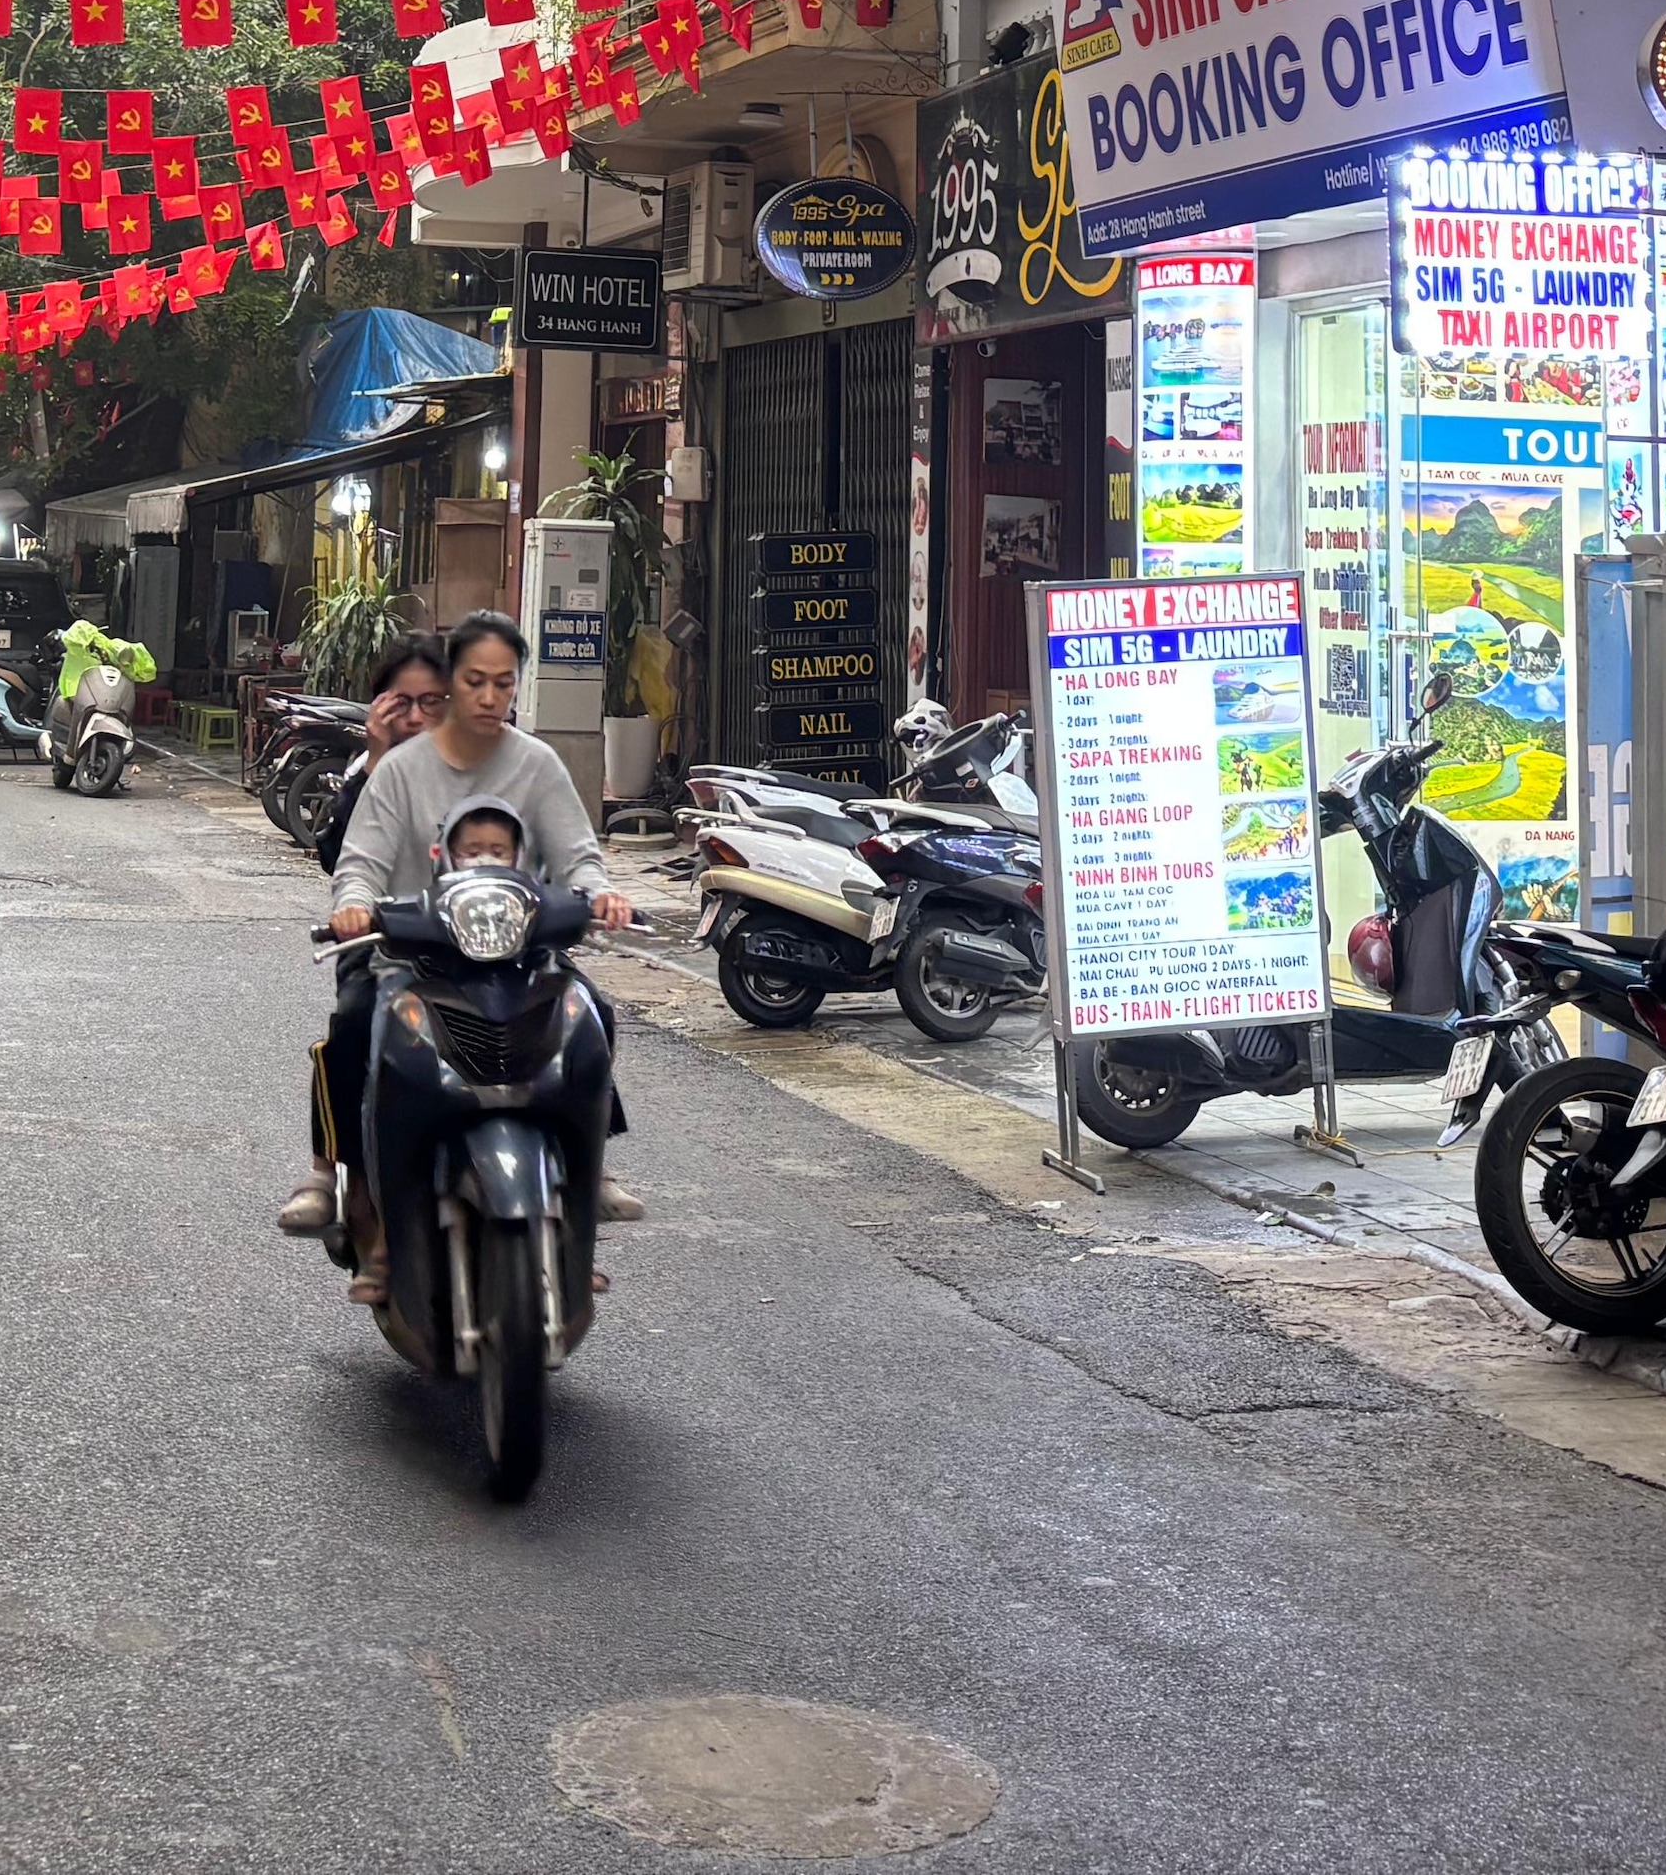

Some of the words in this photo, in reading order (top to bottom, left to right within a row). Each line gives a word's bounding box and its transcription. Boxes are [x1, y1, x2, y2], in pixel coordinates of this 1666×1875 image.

[1066, 43, 1090, 66] SINH
[1090, 35, 1114, 58] CAFE
[1088, 34, 1307, 172] BOOKING
[1481, 128, 1510, 153] 986
[1510, 122, 1540, 152] 309
[1540, 116, 1572, 145] 082
[1412, 160, 1537, 212] BOOKING
[1545, 164, 1637, 214] OFFICE
[793, 206, 828, 221] 1995
[829, 194, 886, 227] Spa
[926, 157, 1001, 263] 1995
[1108, 217, 1121, 240] 28
[1121, 213, 1148, 241] Hang
[1148, 206, 1174, 231] Hanh
[1175, 199, 1207, 225] street
[771, 230, 798, 246] BODY
[803, 230, 829, 246] FOOT
[832, 230, 856, 246] NAIL
[861, 231, 903, 247] WAXING
[1414, 217, 1500, 260] MONEY
[1511, 221, 1639, 265] EXCHANGE
[802, 252, 843, 268] PRIVATE
[844, 252, 873, 268] ROOM
[1156, 263, 1194, 286] LONG
[1199, 262, 1245, 284] BAY
[1416, 265, 1463, 303] SIM
[1472, 267, 1505, 304] 5G
[1532, 268, 1636, 308] LAUNDRY
[531, 272, 575, 304] WIN
[583, 275, 652, 308] HOTEL
[537, 315, 554, 330] 34
[557, 318, 597, 332] HANG
[601, 320, 642, 335] HANH
[1437, 310, 1492, 347] TAXI
[1503, 312, 1620, 350] AIRPORT
[914, 363, 931, 379] Come
[914, 383, 931, 399] Relax
[913, 424, 930, 444] Enjoy
[1302, 423, 1324, 475] TOUR
[1428, 468, 1455, 480] TAM
[1459, 469, 1481, 481] COC
[1500, 471, 1529, 483] MUA
[1533, 472, 1564, 485] CAVE
[1109, 472, 1132, 521] FOOT
[1320, 485, 1338, 511] Long
[1340, 485, 1354, 511] Bay
[1304, 526, 1323, 552] Sapa
[790, 542, 848, 565] BODY
[794, 598, 848, 622] FOOT
[1051, 586, 1147, 631] MONEY
[1155, 581, 1297, 626] EXCHANGE
[589, 620, 601, 635] XE
[1064, 636, 1115, 667] SIM
[1121, 633, 1155, 664] 5G
[1177, 627, 1289, 662] LAUNDRY
[771, 653, 874, 681] SHAMPOO
[1065, 673, 1088, 691] HA
[1094, 670, 1140, 689] LONG
[1147, 668, 1178, 686] BAY
[799, 712, 851, 736] NAIL
[1069, 750, 1113, 769] SAPA
[1118, 744, 1203, 766] TREKKING
[1072, 811, 1093, 828] HA
[1099, 807, 1148, 827] GIANG
[1153, 804, 1194, 823] LOOP
[1525, 830, 1542, 841] DA
[1545, 830, 1575, 841] NANG
[1075, 868, 1115, 887] NINH
[1120, 864, 1158, 884] BINH
[1163, 861, 1215, 881] TOURS
[1075, 889, 1101, 901] HOA
[1123, 886, 1145, 898] TAM
[1148, 885, 1174, 896] COC
[1076, 903, 1101, 914] MUA
[1104, 900, 1133, 912] CAVE
[1146, 898, 1168, 910] DAY
[1164, 915, 1179, 926] AN
[1079, 952, 1124, 965] HANOI
[1128, 948, 1158, 962] CITY
[1162, 945, 1197, 960] TOUR
[1079, 970, 1102, 982] MAI
[1105, 967, 1140, 979] CHAU
[1149, 964, 1164, 976] PU
[1167, 961, 1208, 975] LUONG
[1211, 961, 1219, 973] 2
[1222, 958, 1252, 972] DAYS
[1080, 988, 1099, 1000] BA
[1103, 986, 1119, 998] BE
[1131, 983, 1160, 996] BAN
[1163, 980, 1201, 993] GIOC
[1205, 974, 1279, 991] WATERFALL
[1247, 989, 1319, 1014] TICKETS
